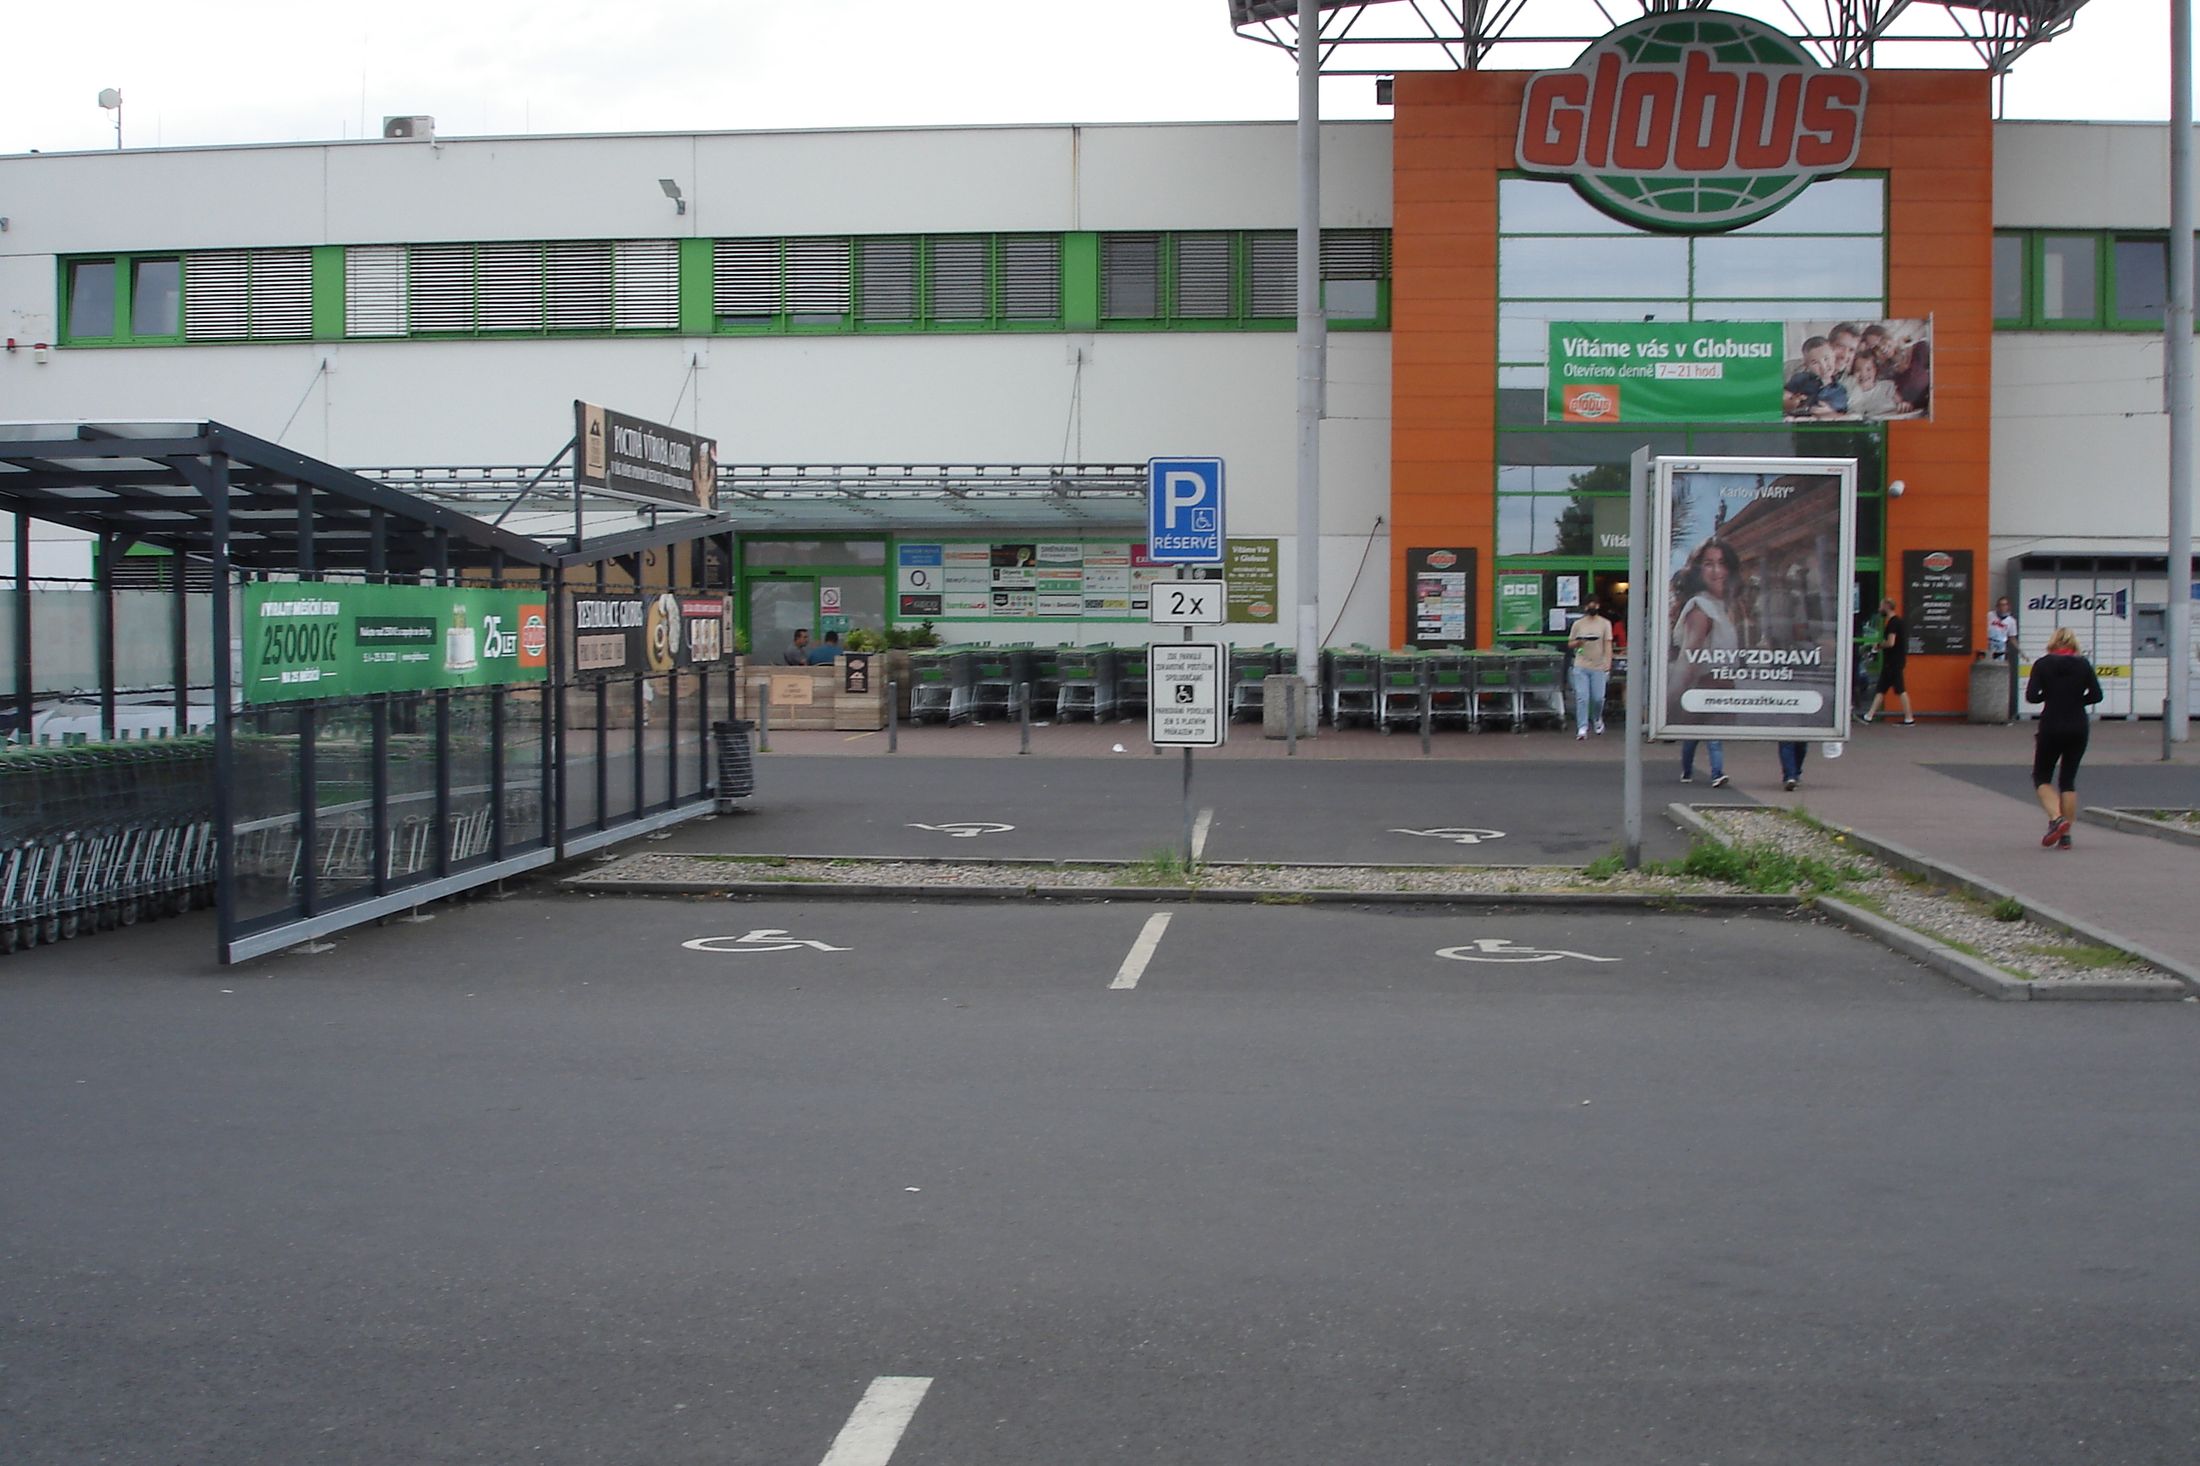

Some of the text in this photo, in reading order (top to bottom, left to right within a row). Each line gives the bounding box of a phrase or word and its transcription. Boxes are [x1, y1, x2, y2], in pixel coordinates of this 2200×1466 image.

[1522, 49, 1861, 171] Globus
[1562, 338, 1773, 358] Vítáme vás v Globusu
[1563, 363, 1615, 377] Otevřeno
[1618, 362, 1654, 377] denně
[1165, 471, 1206, 528] P
[1154, 533, 1217, 549] RÉSERVÉ
[1600, 534, 1630, 547] Vítá
[2028, 594, 2108, 610] alzaBox
[322, 622, 339, 661] Kč
[483, 615, 501, 658] 25
[502, 635, 517, 653] LET
[1711, 667, 1794, 680] TĚLO I DUŠI
